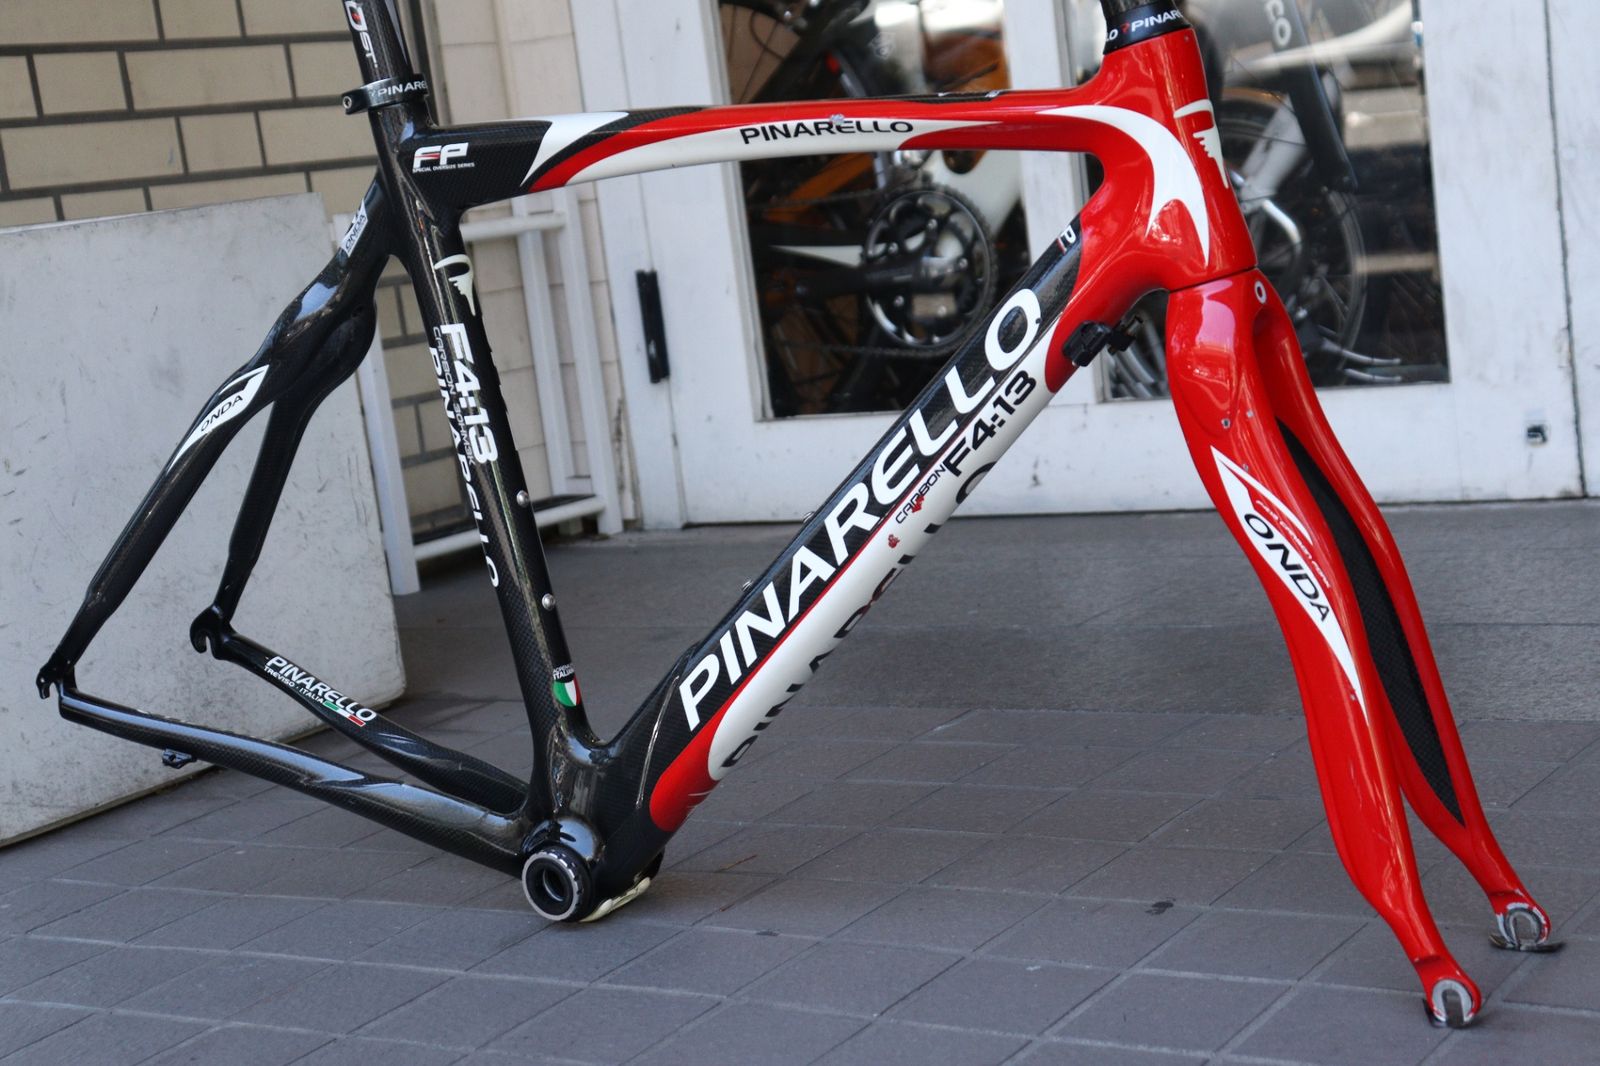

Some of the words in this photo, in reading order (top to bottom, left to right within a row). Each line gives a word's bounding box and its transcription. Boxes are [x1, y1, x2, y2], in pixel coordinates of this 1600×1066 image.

[739, 120, 914, 145] PINARELLO
[432, 326, 457, 396] CARBON
[440, 322, 499, 465] F4:13
[201, 394, 244, 432] ONDA
[895, 464, 946, 524] CARBON
[942, 370, 1037, 477] F4:13
[678, 288, 1041, 732] PINARELLO
[1244, 513, 1330, 622] ONDA
[265, 655, 378, 722] PINARELLO
[299, 687, 325, 704] ITALIA
